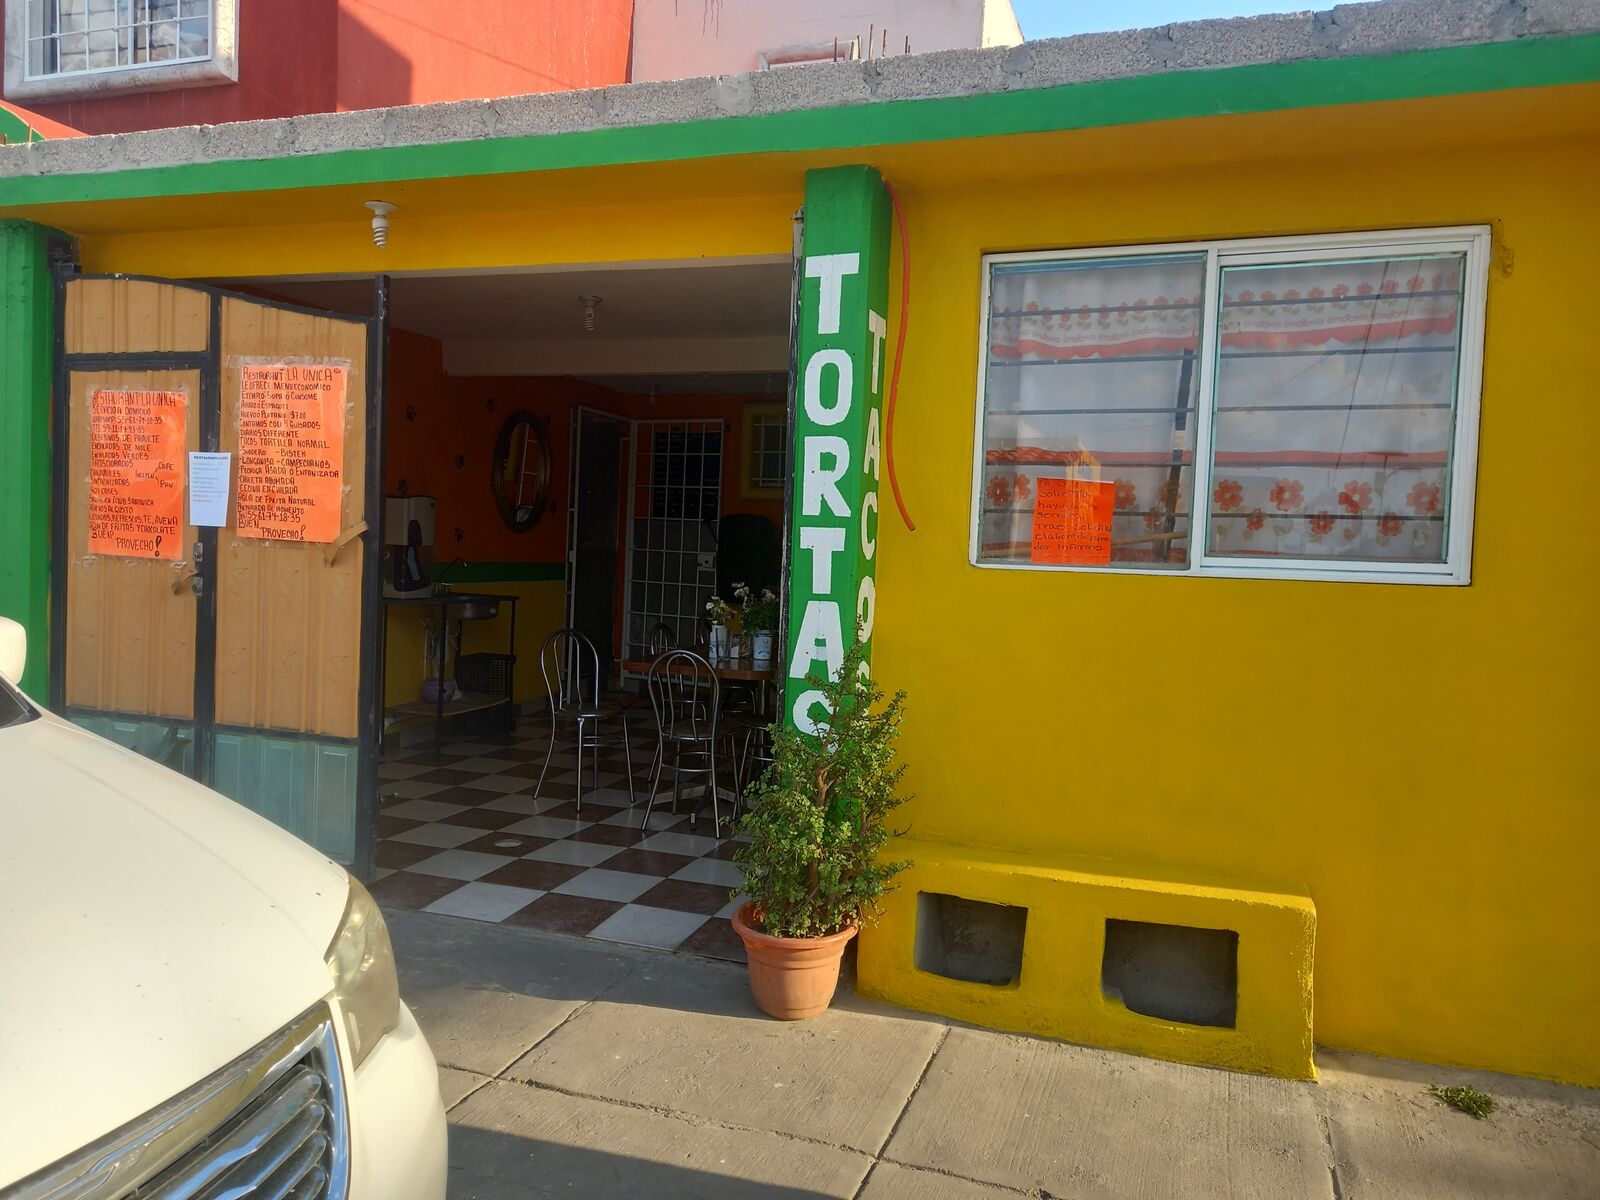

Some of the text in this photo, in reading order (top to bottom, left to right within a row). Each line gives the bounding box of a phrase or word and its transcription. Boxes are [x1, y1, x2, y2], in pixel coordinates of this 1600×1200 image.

[260, 437, 293, 447] TORTILLA
[297, 440, 331, 449] NORMAL
[288, 495, 316, 507] NATURAL
